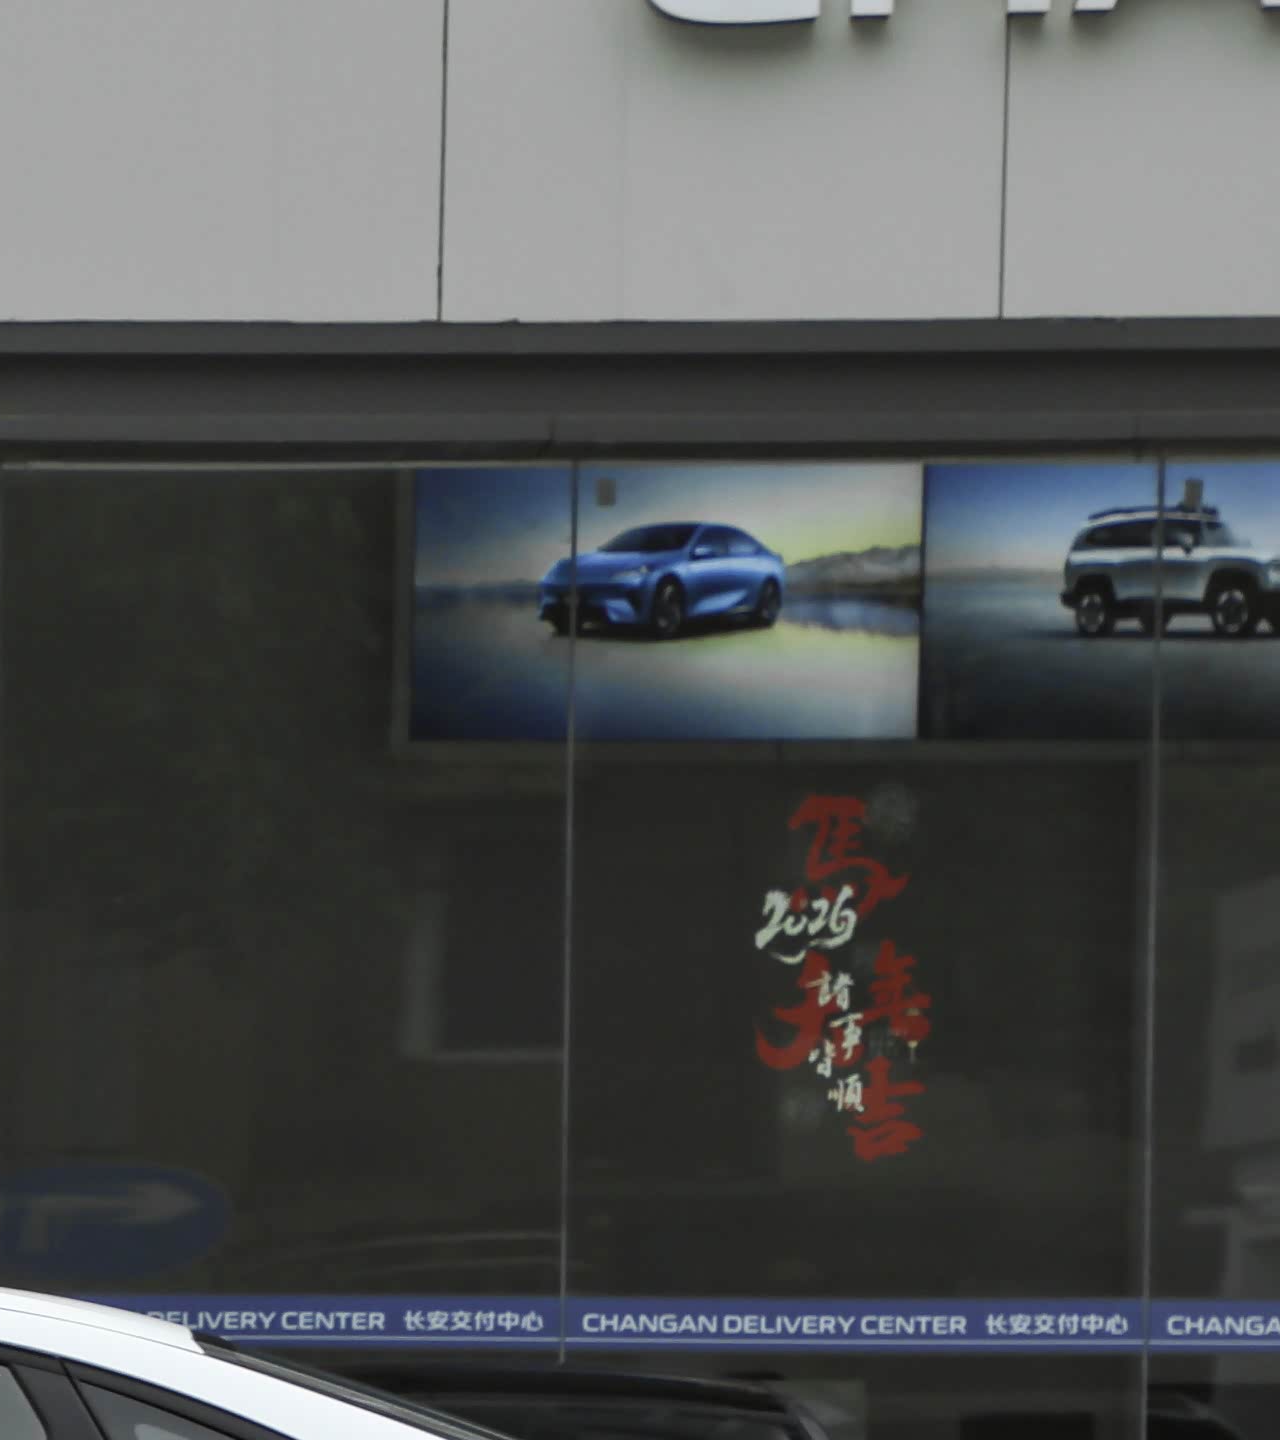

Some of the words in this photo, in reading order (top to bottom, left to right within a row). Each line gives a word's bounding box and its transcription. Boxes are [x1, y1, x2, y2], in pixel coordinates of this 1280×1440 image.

[754, 883, 858, 964] 2026
[280, 1310, 386, 1331] CENTER
[403, 1310, 544, 1332] 长安交付中心
[581, 1312, 718, 1333] CHANGAN
[722, 1314, 855, 1335] DELIVERY
[860, 1315, 967, 1335] CENTER
[985, 1313, 1129, 1336] 长安交付中心
